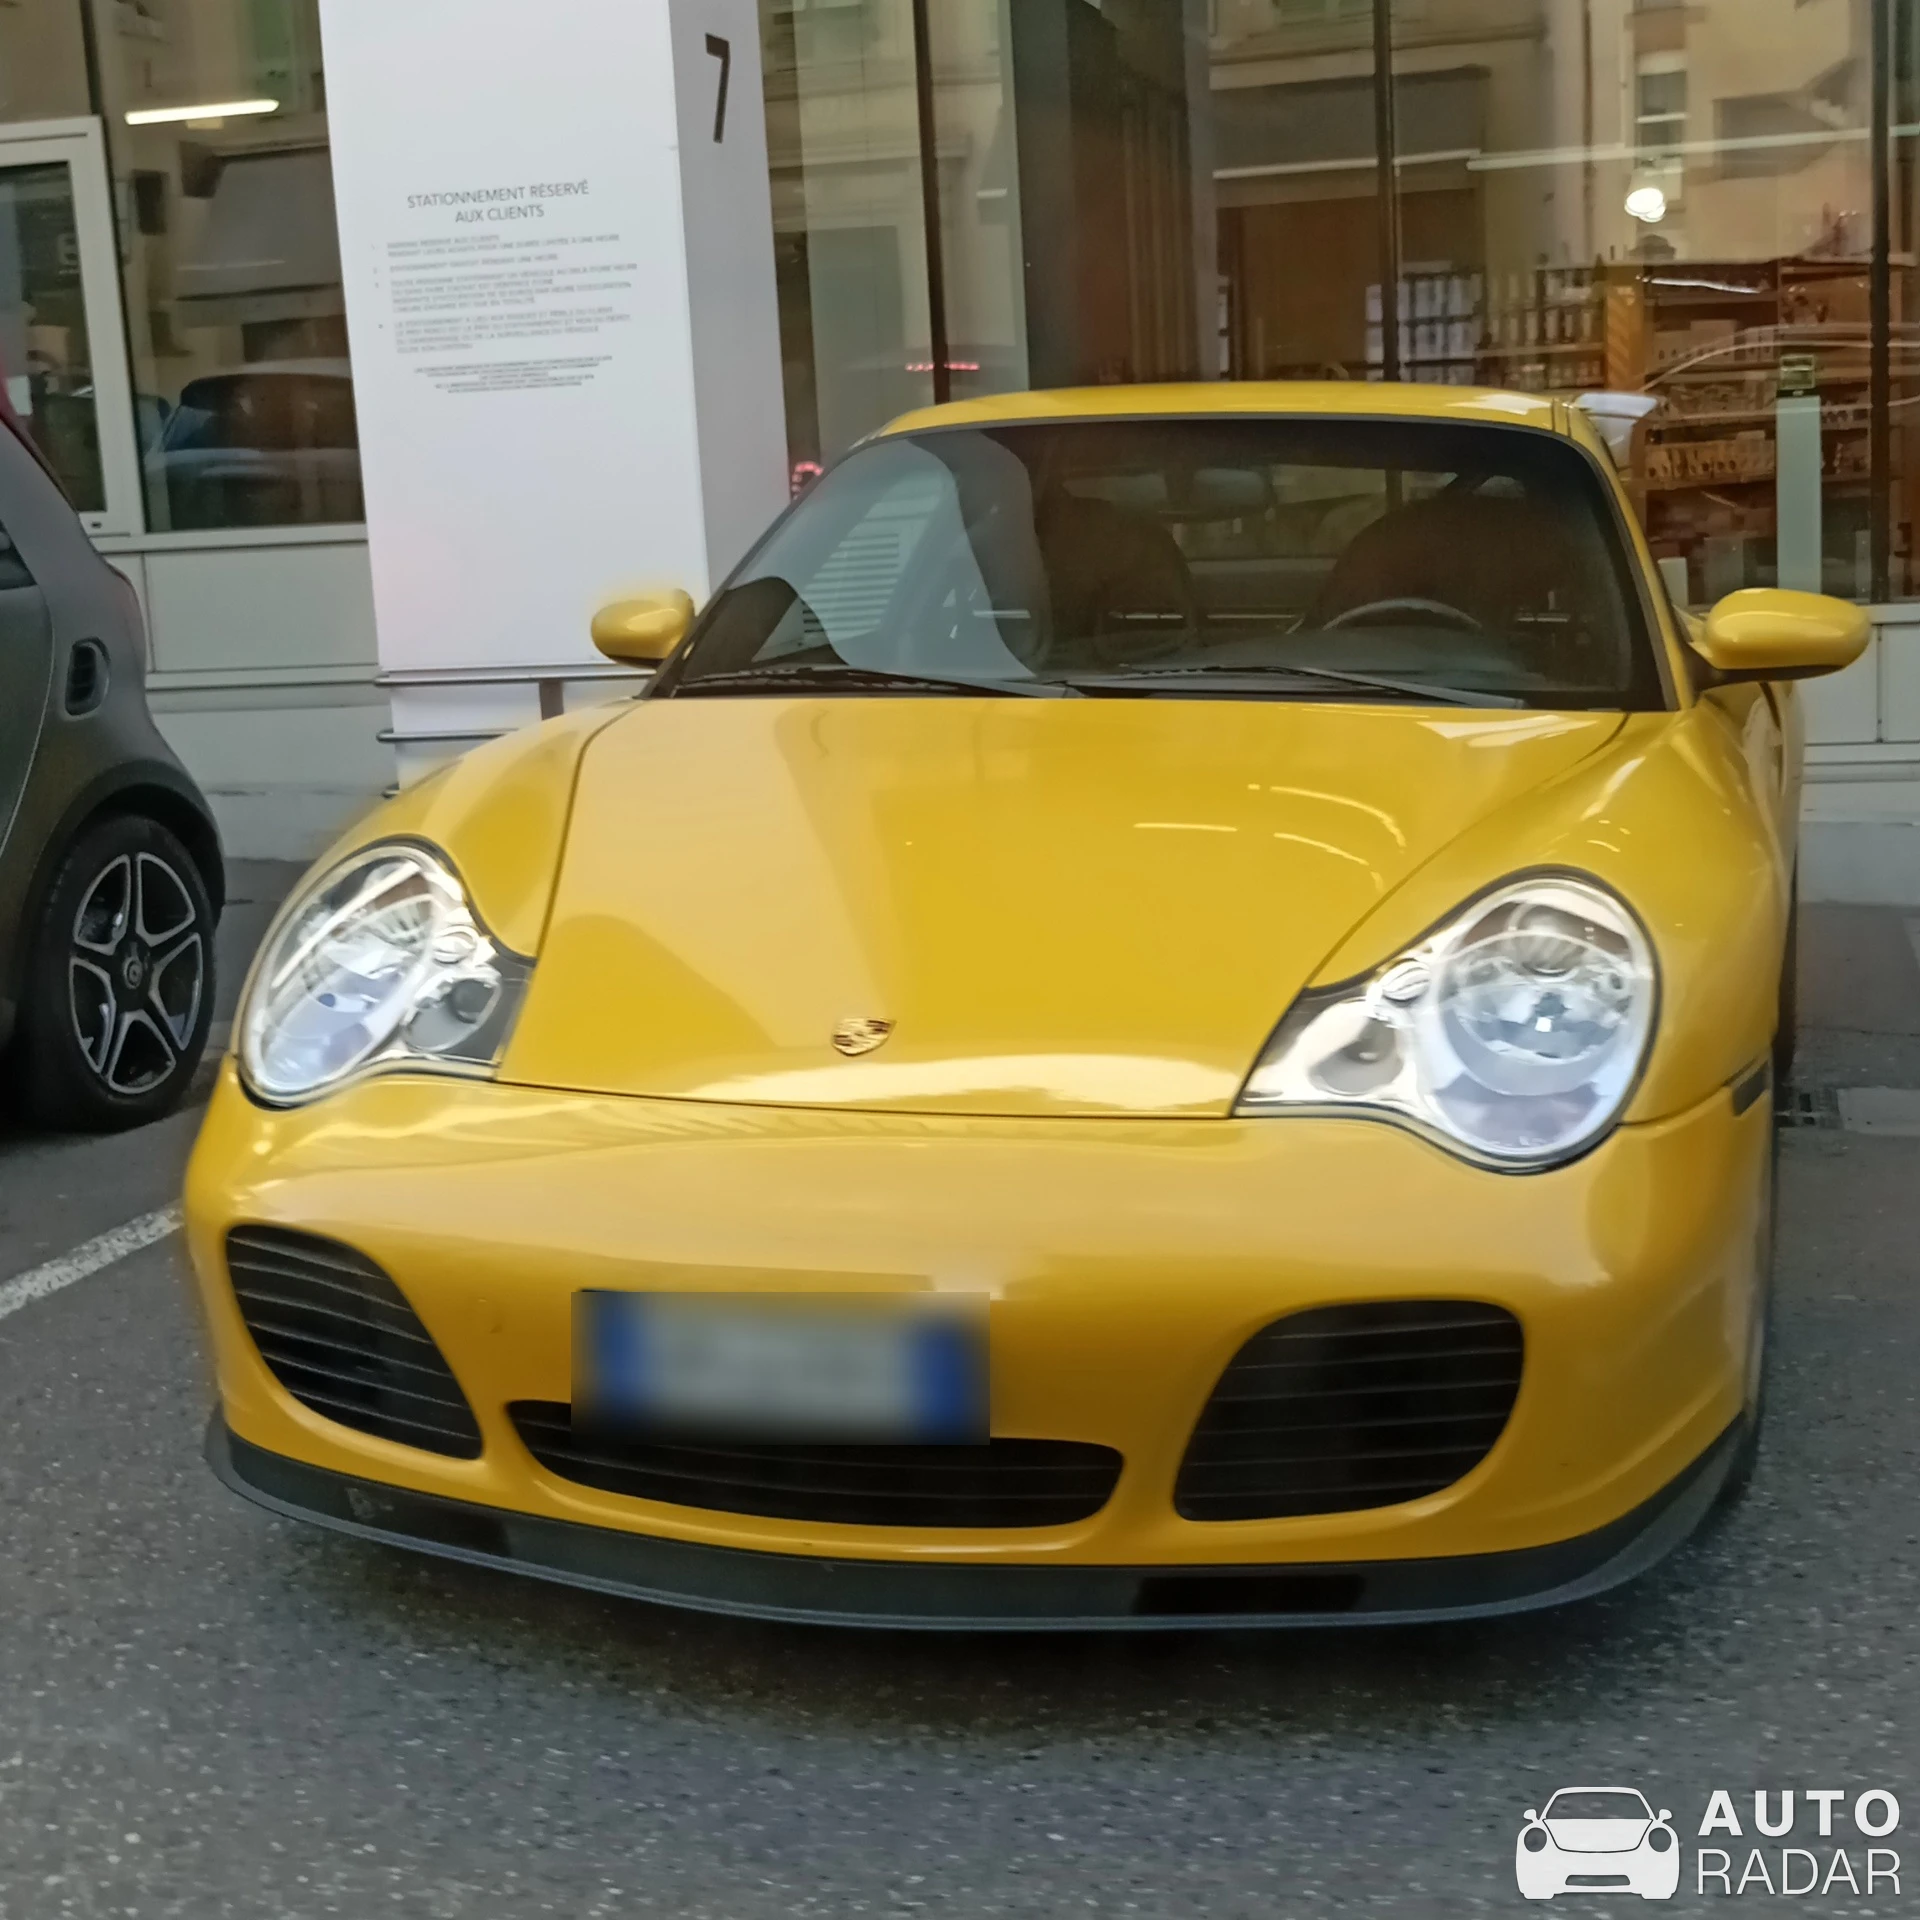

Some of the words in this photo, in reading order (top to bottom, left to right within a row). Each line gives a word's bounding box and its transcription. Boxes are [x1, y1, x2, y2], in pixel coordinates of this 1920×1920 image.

[704, 32, 730, 144] 7
[407, 186, 525, 208] STATIONNEMENT
[529, 179, 590, 198] RÉSERVÉ
[455, 209, 484, 223] AUX
[487, 204, 545, 221] CLIENTS
